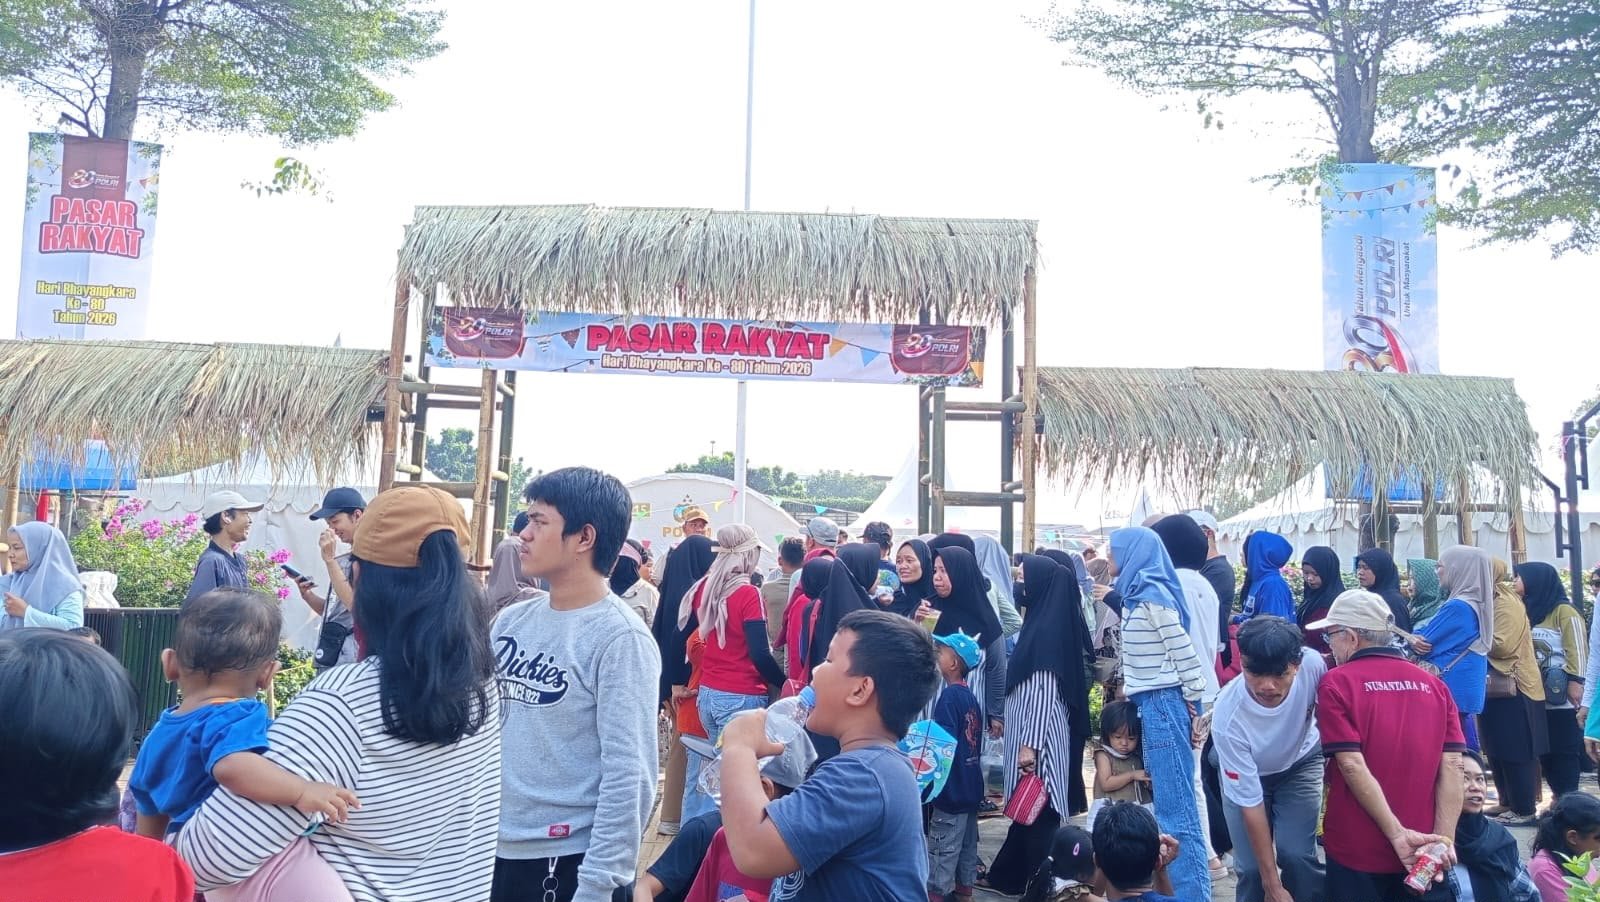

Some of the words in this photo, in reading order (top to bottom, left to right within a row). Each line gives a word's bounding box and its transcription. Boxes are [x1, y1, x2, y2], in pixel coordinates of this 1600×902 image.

[51, 196, 136, 229] PASAR
[41, 222, 143, 258] RAKYAT
[1373, 235, 1396, 318] POLRI
[1402, 241, 1411, 291] Masyarakat
[36, 280, 62, 295] Hari
[62, 282, 136, 298] Bhayangkara
[66, 296, 81, 310] Ke
[89, 298, 105, 311] 80
[1402, 293, 1411, 318] Untuk
[53, 309, 86, 324] Tahun
[86, 311, 117, 325] 2026
[484, 327, 514, 336] POLRI
[586, 322, 698, 354] PASAR
[701, 322, 830, 360] RAKYAT
[932, 343, 959, 353] POLRI
[601, 353, 627, 368] Hari
[628, 354, 704, 373] Bhayangkara
[705, 358, 722, 373] Ke
[730, 359, 746, 373] 80
[748, 359, 782, 375] Tahun
[782, 360, 813, 376] 2026
[496, 635, 567, 688] Dickies
[500, 681, 526, 700] SINCE
[1364, 680, 1418, 692] NUSANTARA
